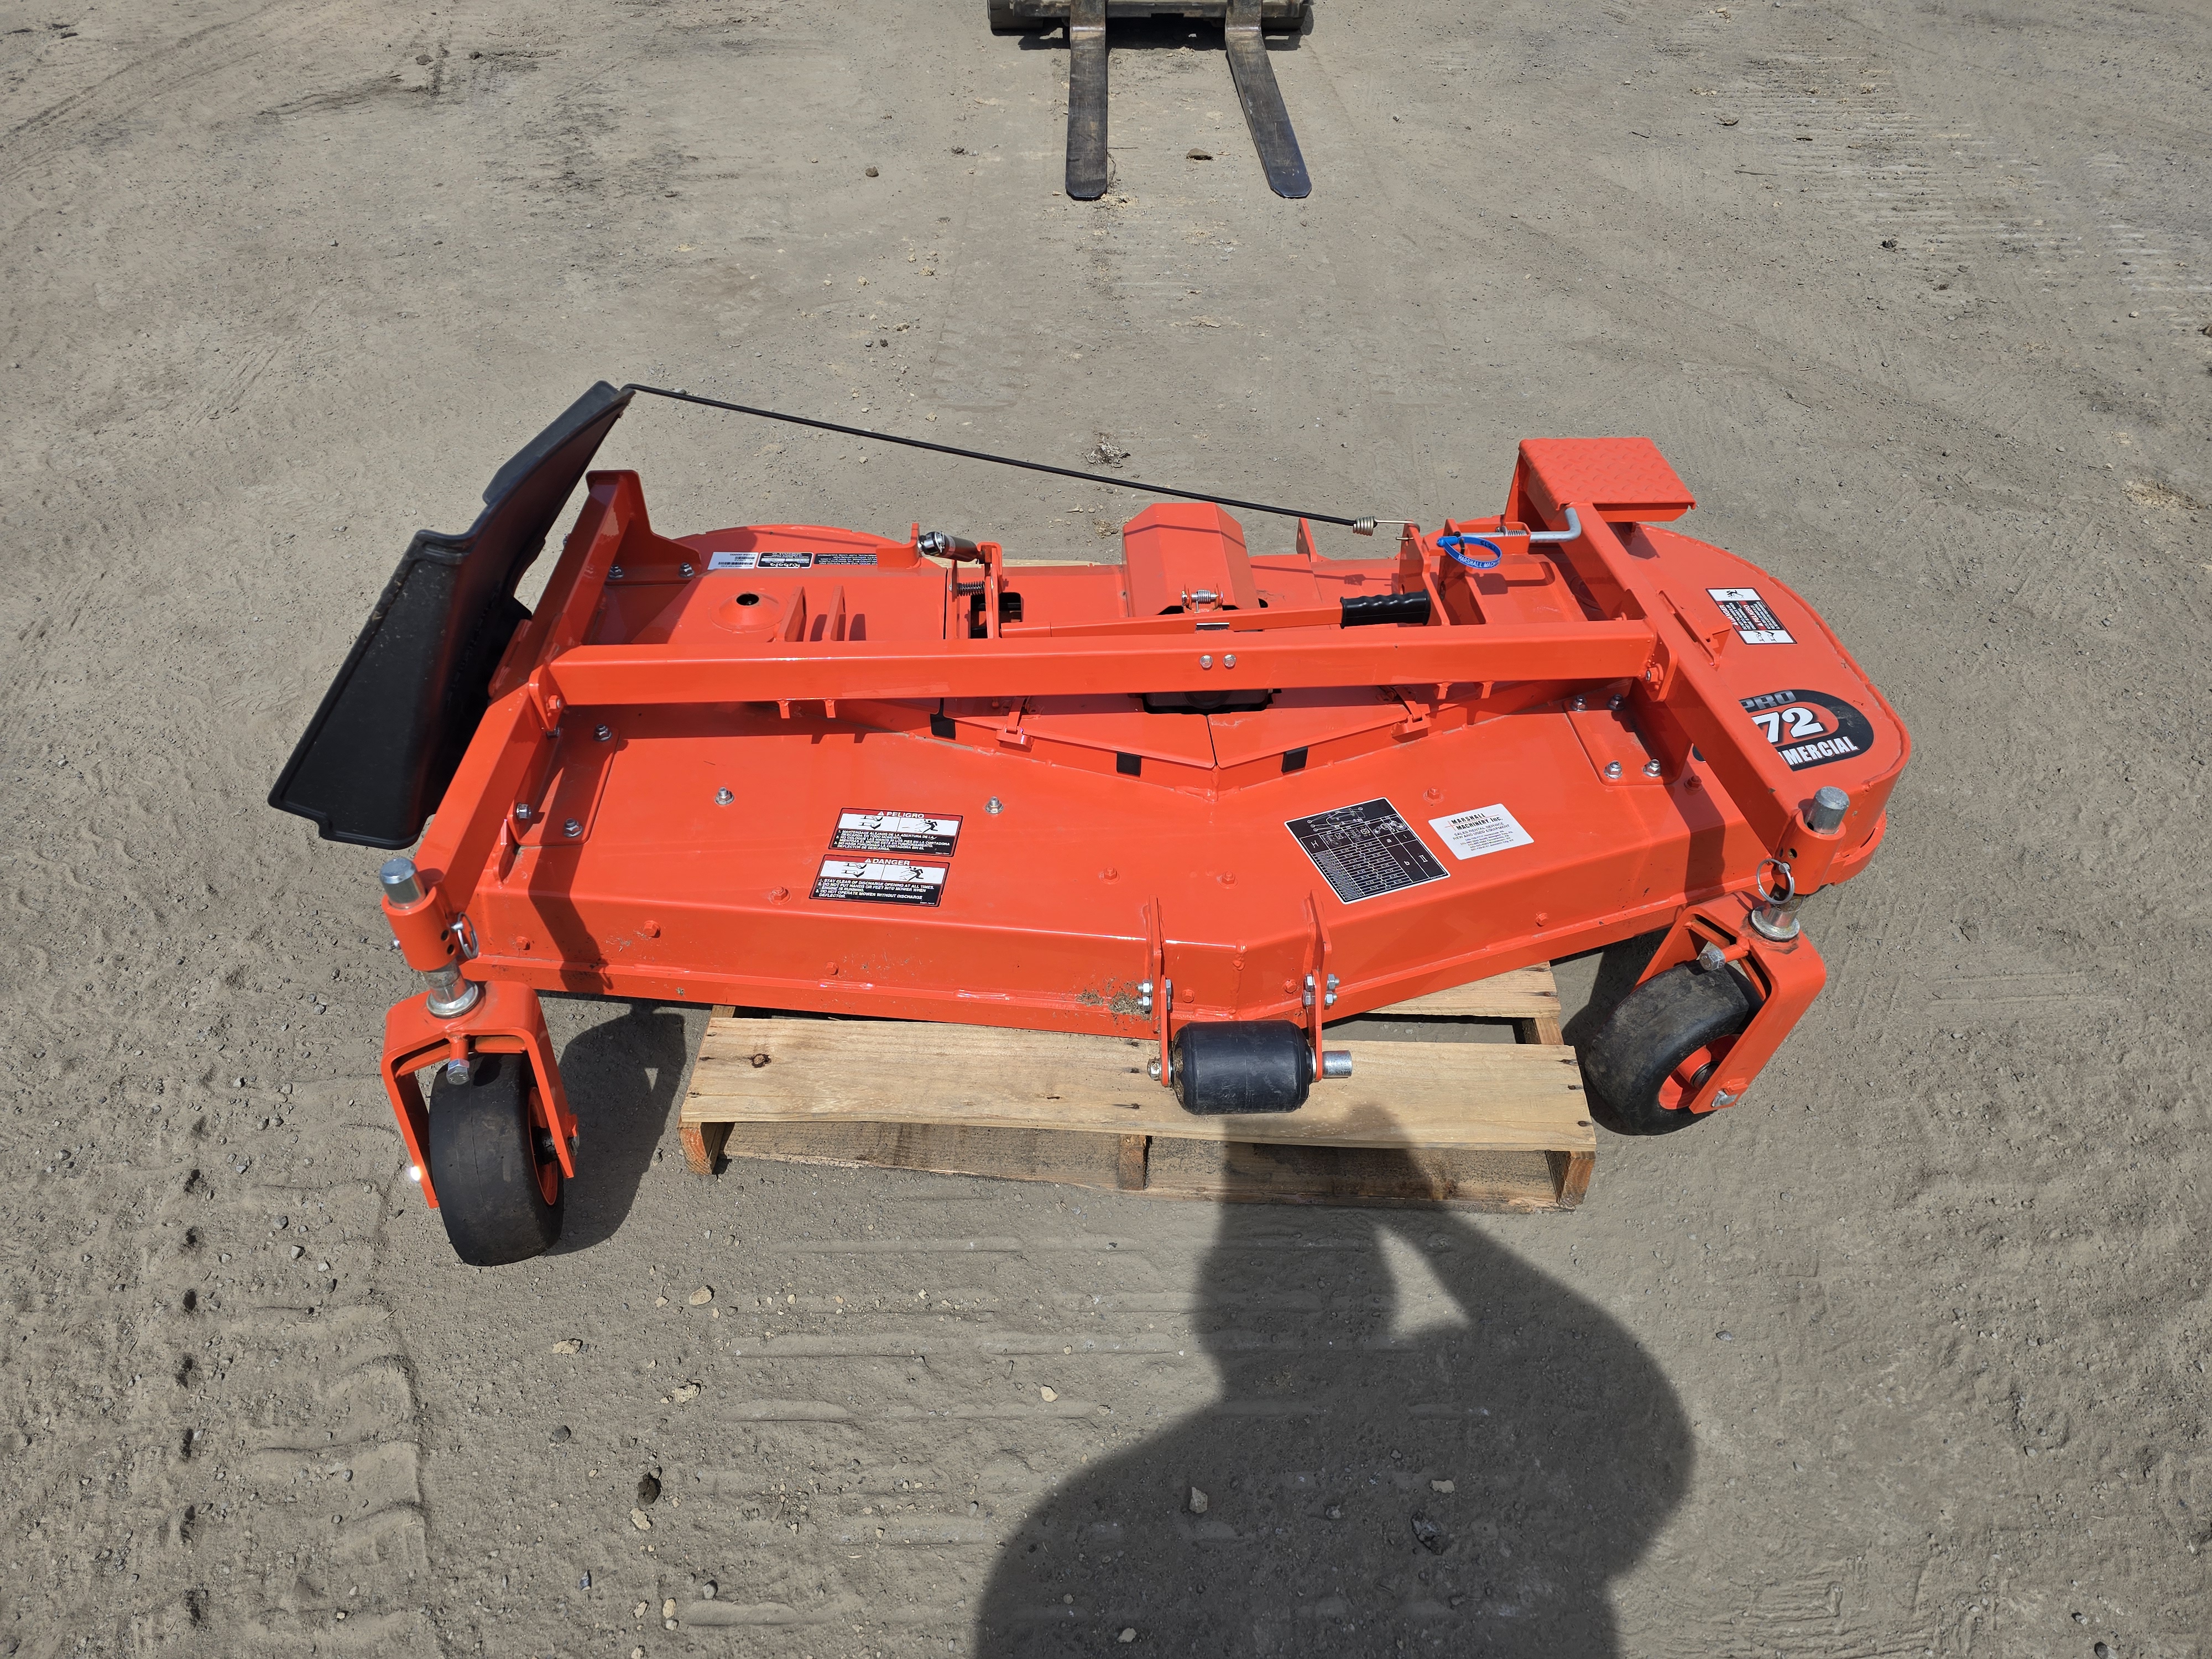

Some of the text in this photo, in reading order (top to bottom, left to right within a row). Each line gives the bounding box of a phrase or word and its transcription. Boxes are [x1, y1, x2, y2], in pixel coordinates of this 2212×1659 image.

[1458, 554, 1483, 568] MARSHALL
[1739, 690, 1797, 709] PRO
[1751, 707, 1824, 743] 72
[1777, 736, 1860, 766] MERCIAL
[1450, 812, 1486, 825] MARSHALL
[1455, 818, 1491, 831] MACHINERY,
